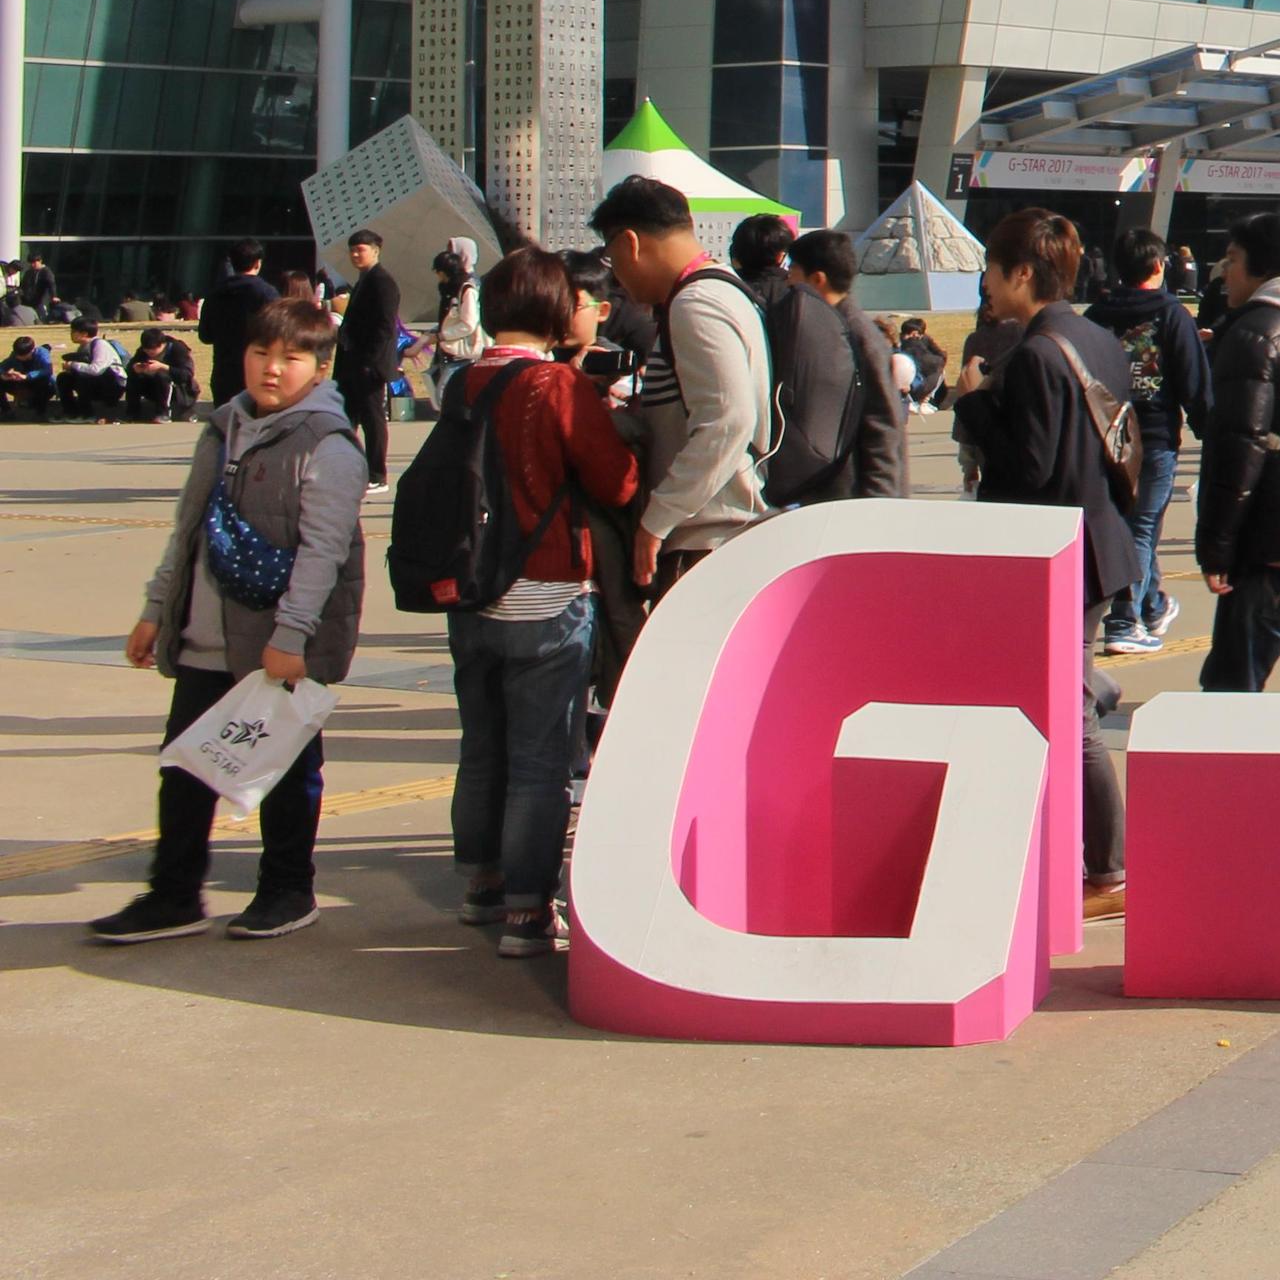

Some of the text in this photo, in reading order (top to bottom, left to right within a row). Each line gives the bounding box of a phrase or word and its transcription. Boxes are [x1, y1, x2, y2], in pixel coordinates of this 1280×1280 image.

[1008, 158, 1046, 172] G-STAR
[1048, 160, 1073, 174] 2017
[1207, 165, 1240, 178] G-STAR
[1241, 167, 1263, 179] 2017
[954, 173, 964, 193] 1
[200, 741, 241, 777] G-STAR
